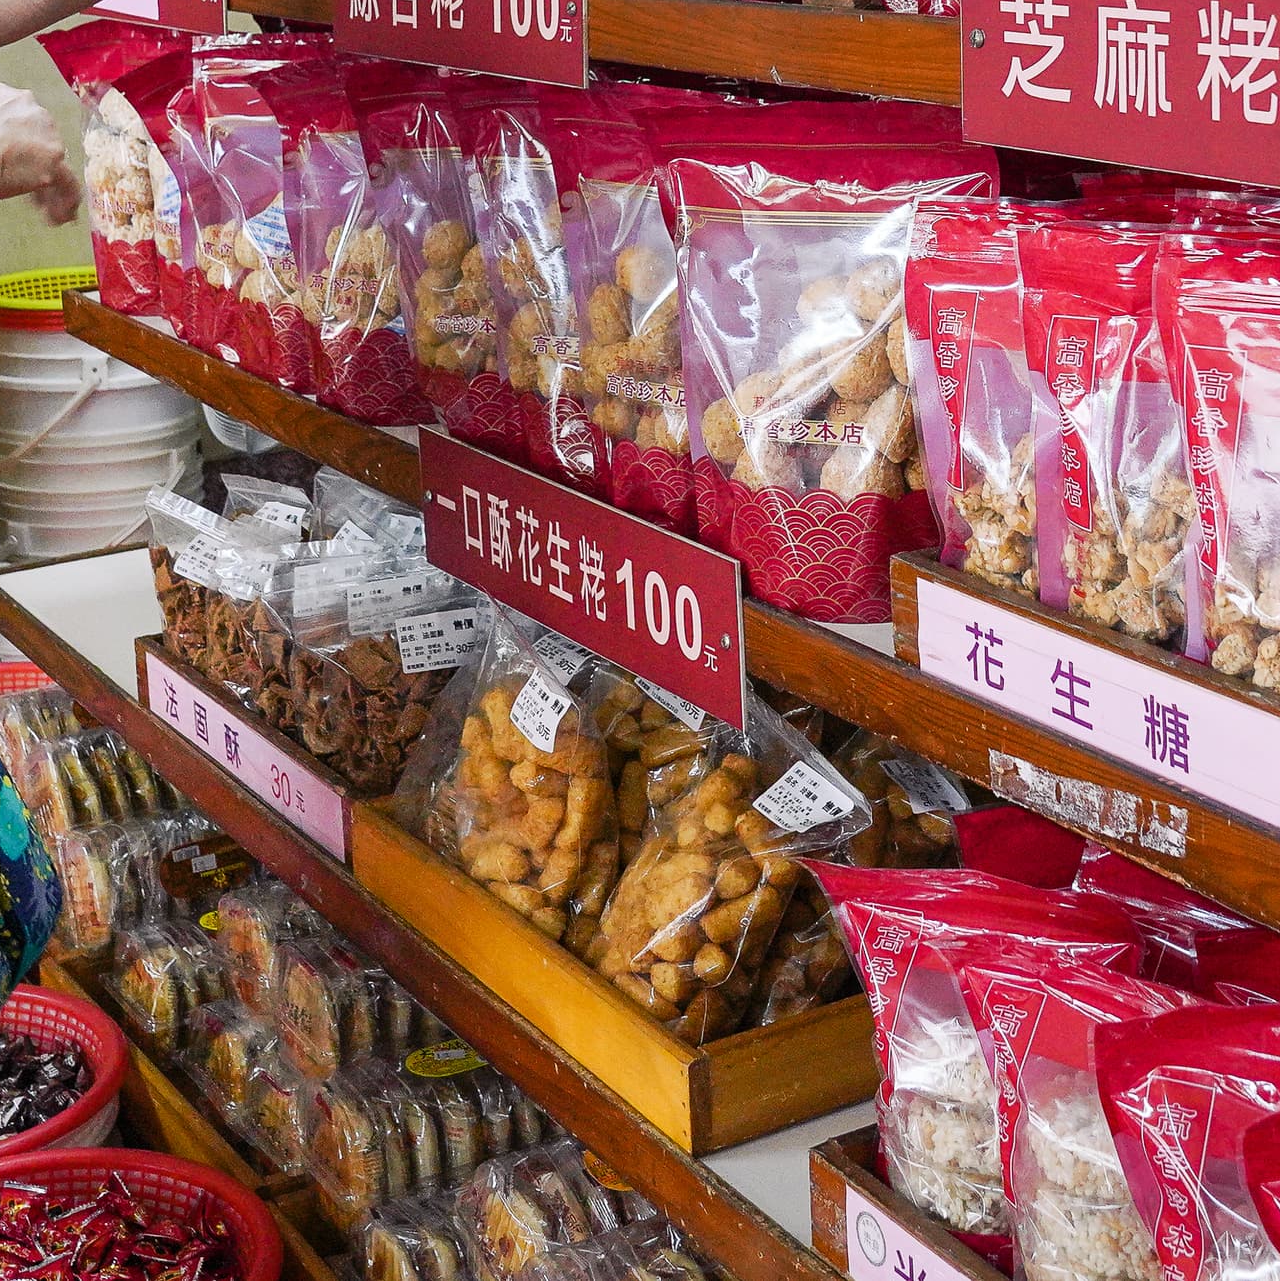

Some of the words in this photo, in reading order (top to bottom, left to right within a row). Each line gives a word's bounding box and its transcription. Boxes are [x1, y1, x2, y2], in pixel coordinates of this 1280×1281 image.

[437, 485, 608, 621] 一口酥花生粩
[615, 559, 719, 672] 100元
[456, 641, 476, 655] 30元
[679, 700, 701, 720] 30元
[966, 621, 1190, 774] 花生糖
[270, 763, 307, 813] 30元
